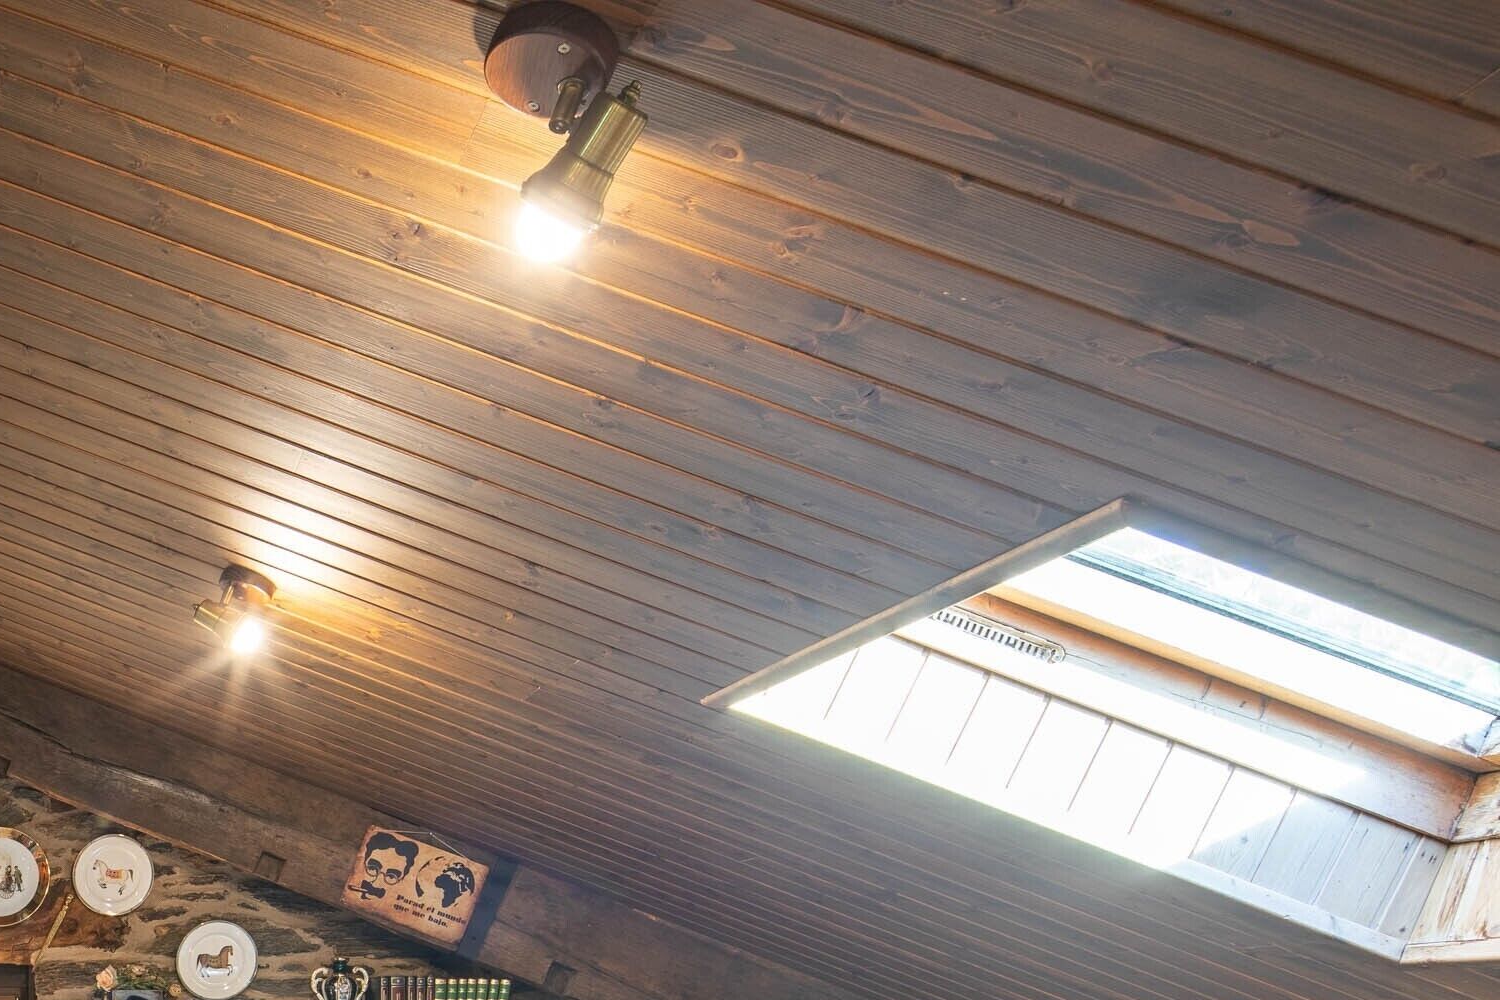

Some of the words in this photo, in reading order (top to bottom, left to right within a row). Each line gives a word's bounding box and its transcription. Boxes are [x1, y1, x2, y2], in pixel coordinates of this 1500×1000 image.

[393, 902, 410, 914] que
[411, 911, 425, 919] me
[428, 914, 448, 928] bajo.
[396, 894, 425, 910] Parad
[426, 905, 436, 913] el
[437, 909, 467, 924] mundo
